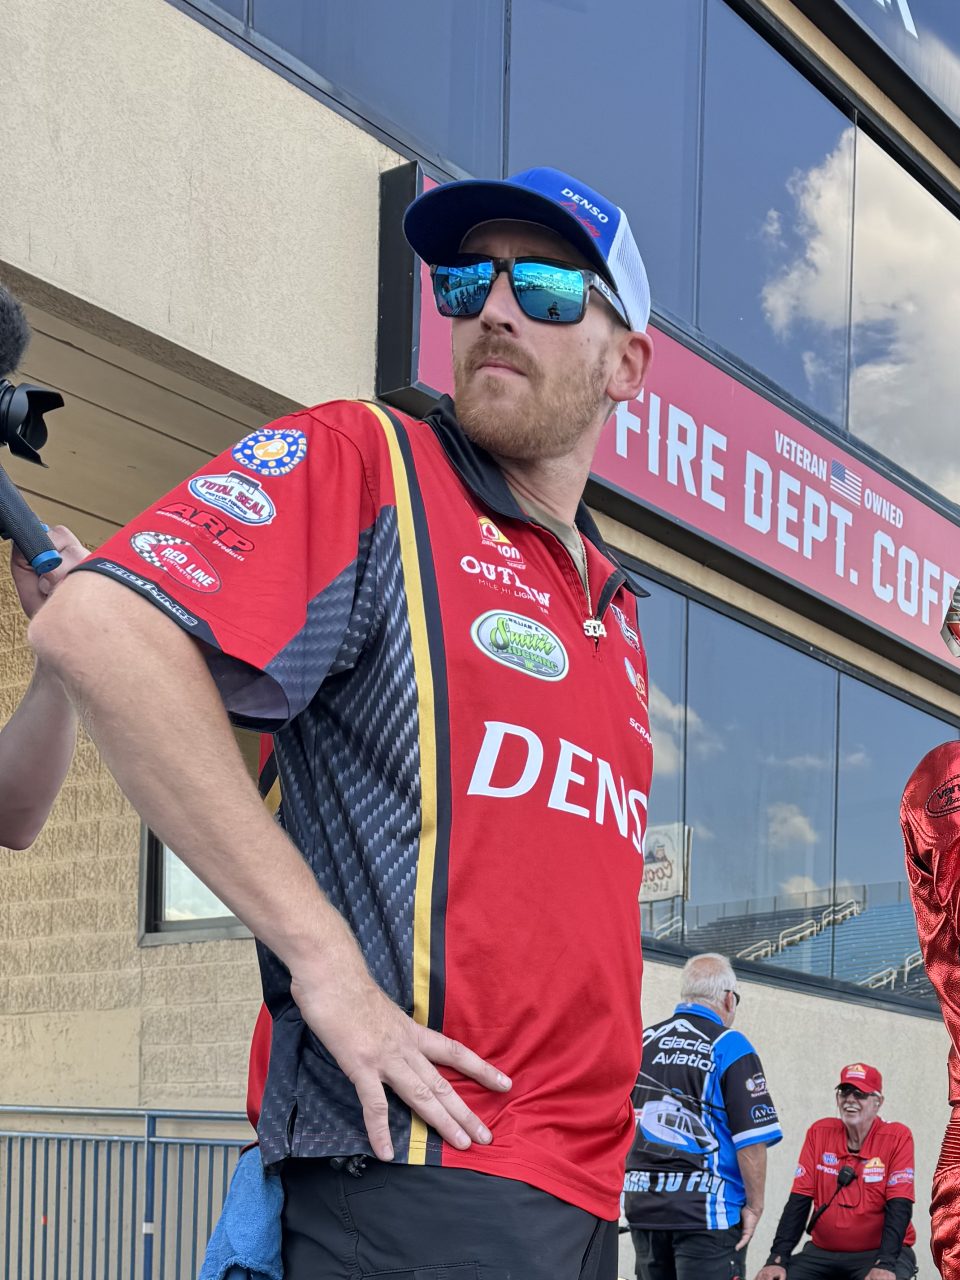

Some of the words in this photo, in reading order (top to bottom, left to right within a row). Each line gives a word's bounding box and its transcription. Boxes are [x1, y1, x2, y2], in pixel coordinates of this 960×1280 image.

[561, 188, 608, 223] DENSO
[200, 479, 233, 498] TOTAL
[234, 491, 266, 518] SEAL
[774, 430, 827, 482] VETERAN
[864, 488, 903, 529] OWNED
[157, 502, 255, 552] ARP
[615, 389, 727, 512] FIRE
[744, 450, 858, 585] DEPT.
[872, 530, 959, 626] COFF
[160, 547, 188, 565] RED
[186, 562, 216, 588] LINE
[467, 721, 648, 854] DENS
